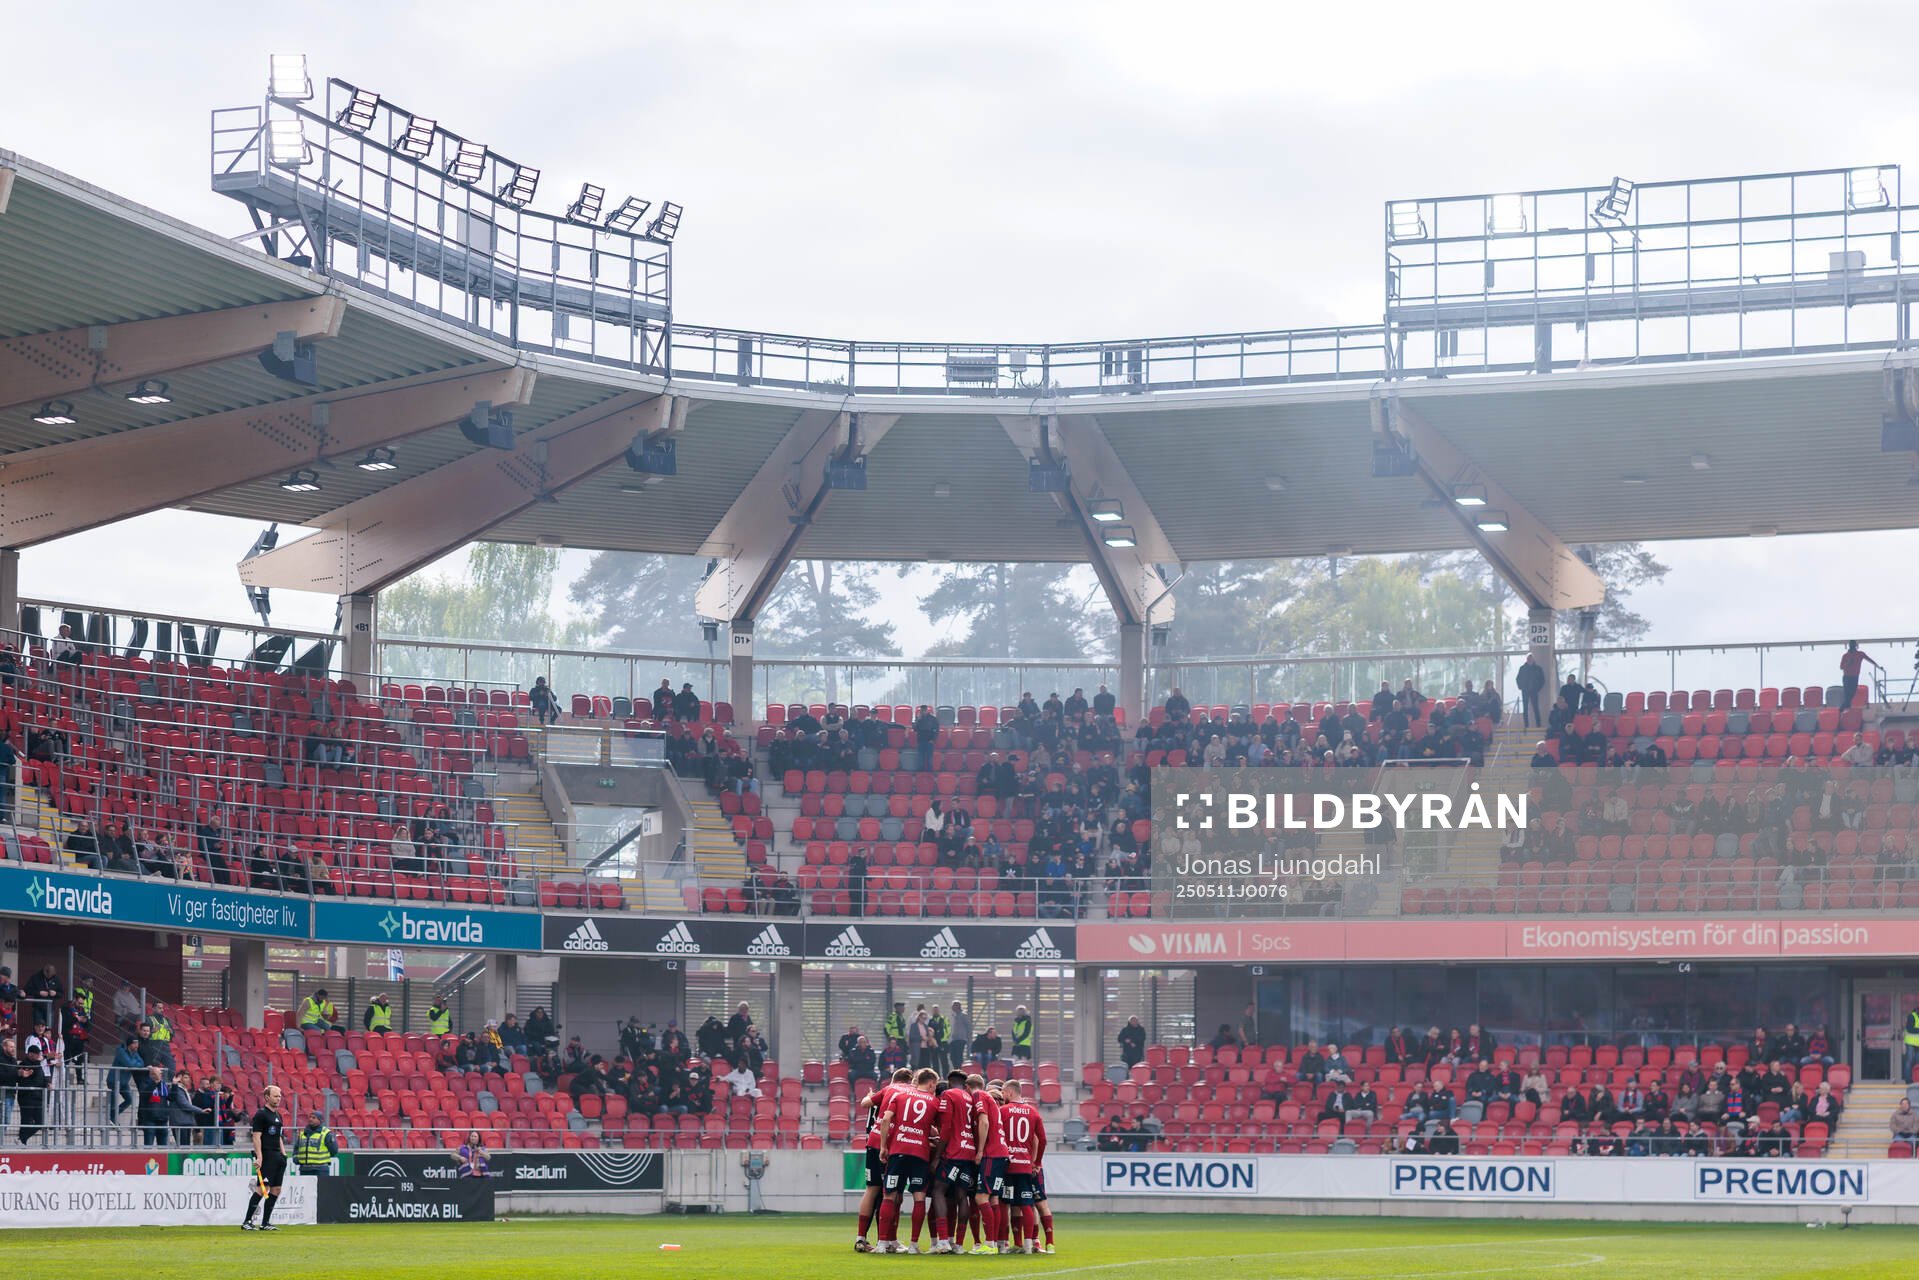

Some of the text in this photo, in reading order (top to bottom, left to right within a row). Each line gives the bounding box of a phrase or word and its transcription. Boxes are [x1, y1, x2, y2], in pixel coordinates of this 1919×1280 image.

[735, 636, 744, 644] D1
[46, 878, 112, 915] bravida
[168, 893, 298, 928] Vi ger fastigheter liv.
[403, 911, 483, 943] bravida
[563, 938, 609, 951] adidas
[1162, 932, 1291, 954] VISMA Spcs
[1522, 922, 1868, 951] Ekonomisystem för din passion
[656, 941, 700, 953] adidas
[747, 943, 790, 956] adidas
[825, 944, 871, 957] adidas
[920, 945, 966, 958] adidas
[1015, 946, 1061, 959] adidas
[667, 961, 677, 970] C2
[1252, 966, 1263, 975] C3
[1679, 962, 1690, 972] C4
[903, 1098, 927, 1124] 19
[1009, 1116, 1030, 1143] 10
[515, 1165, 568, 1179] stadium
[1106, 1162, 1254, 1188] PREMON
[1395, 1165, 1550, 1192] PREMON
[401, 1182, 414, 1193] 1950
[1700, 1168, 1863, 1195] PREMON
[0, 1192, 226, 1210] URANG HOTELL KONDITORI
[350, 1196, 463, 1219] SMÅLÄNDSKA BIL
